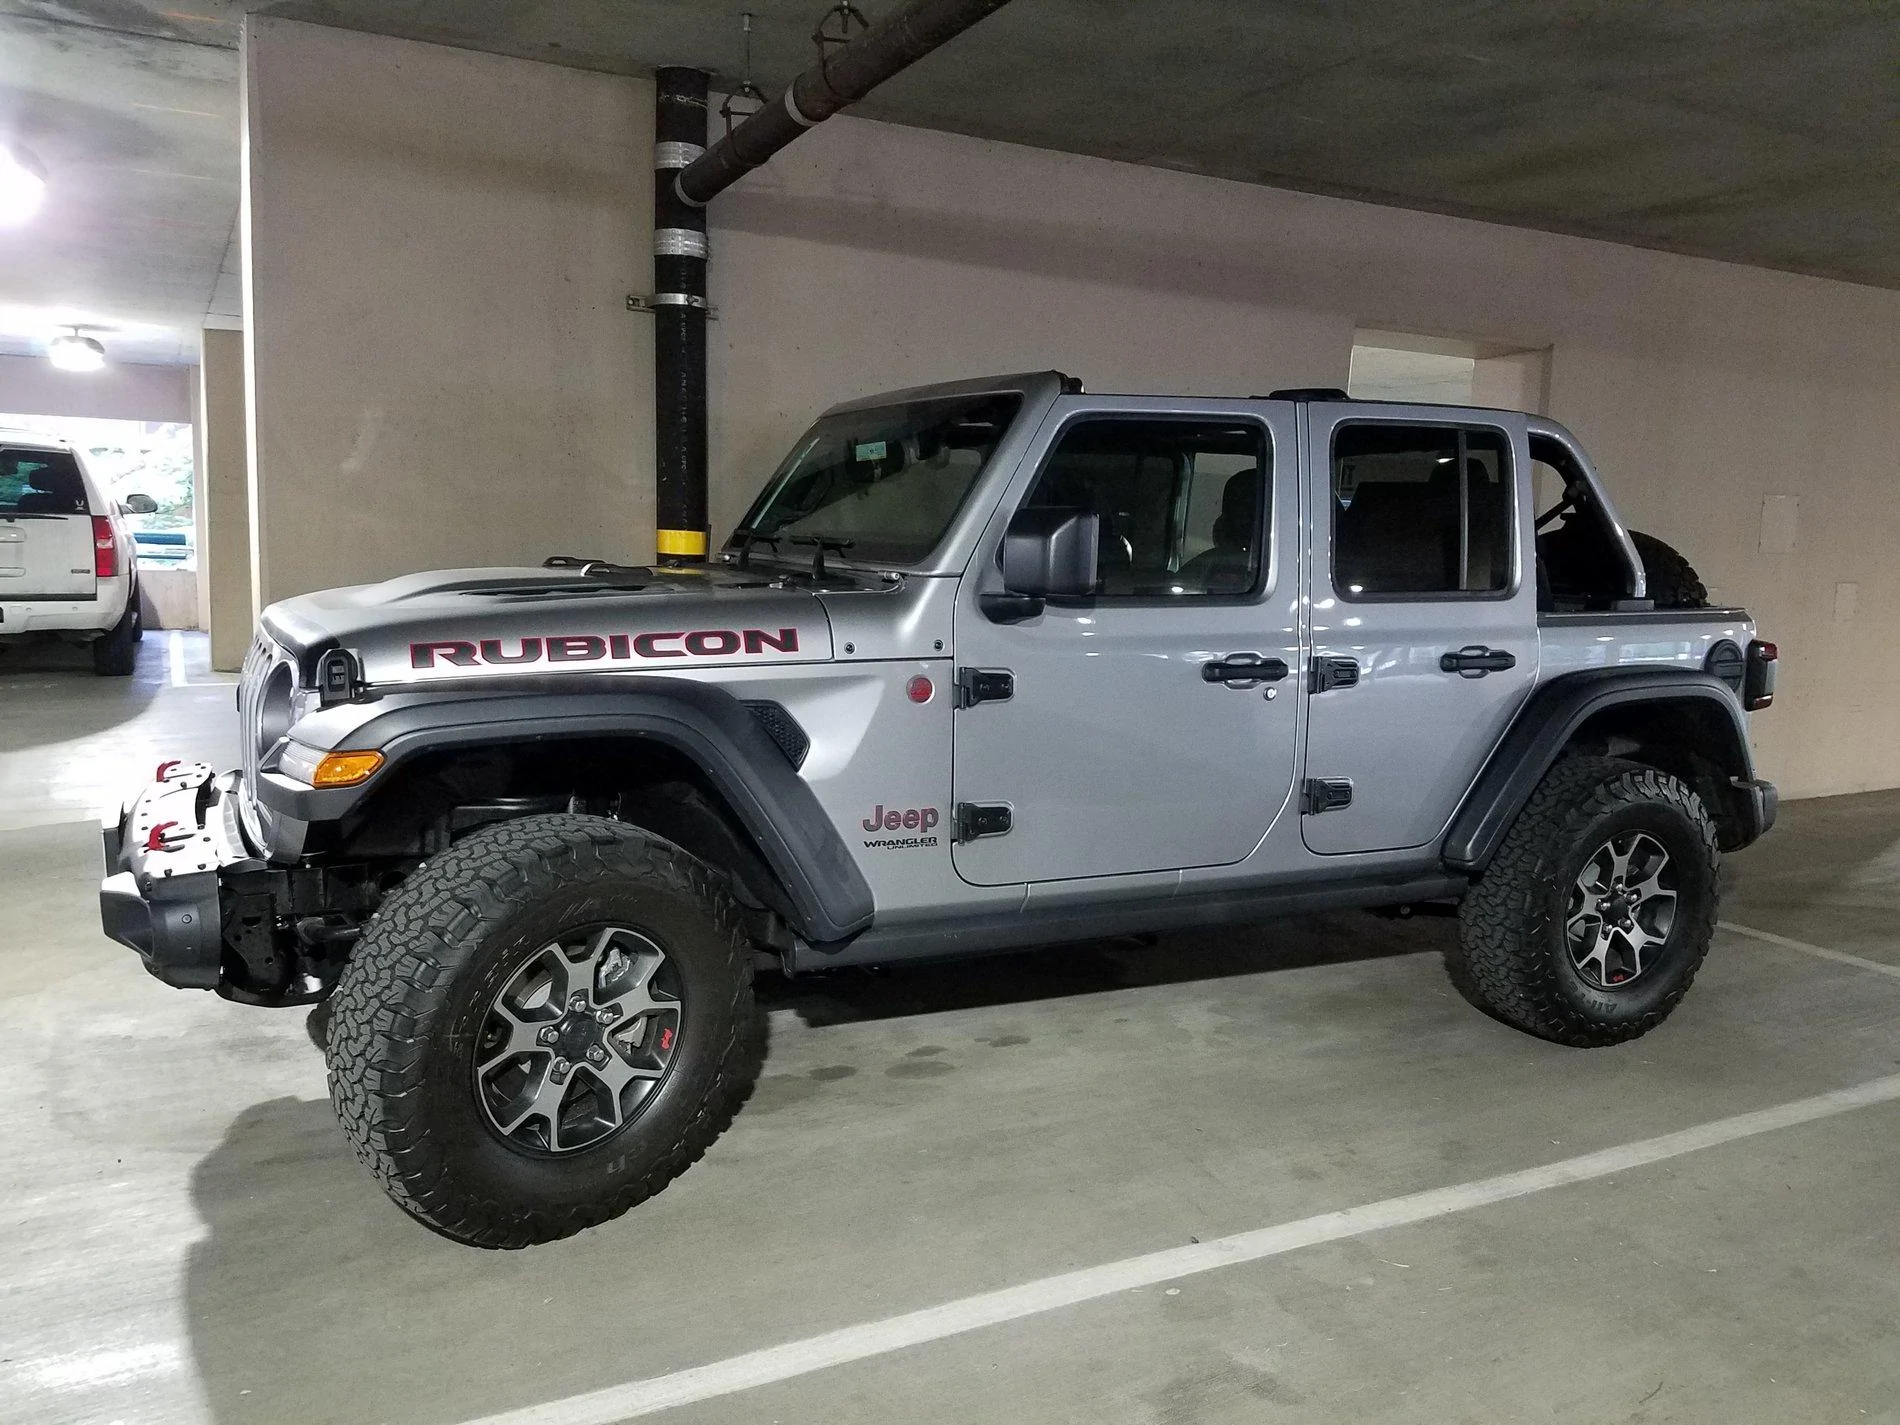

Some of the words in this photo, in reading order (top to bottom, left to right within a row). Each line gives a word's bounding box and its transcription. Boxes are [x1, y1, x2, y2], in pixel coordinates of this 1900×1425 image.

[410, 628, 799, 668] RUBICON
[862, 804, 939, 833] Jeep
[863, 836, 938, 848] WRANGLER
[887, 842, 938, 850] UNLIMITED
